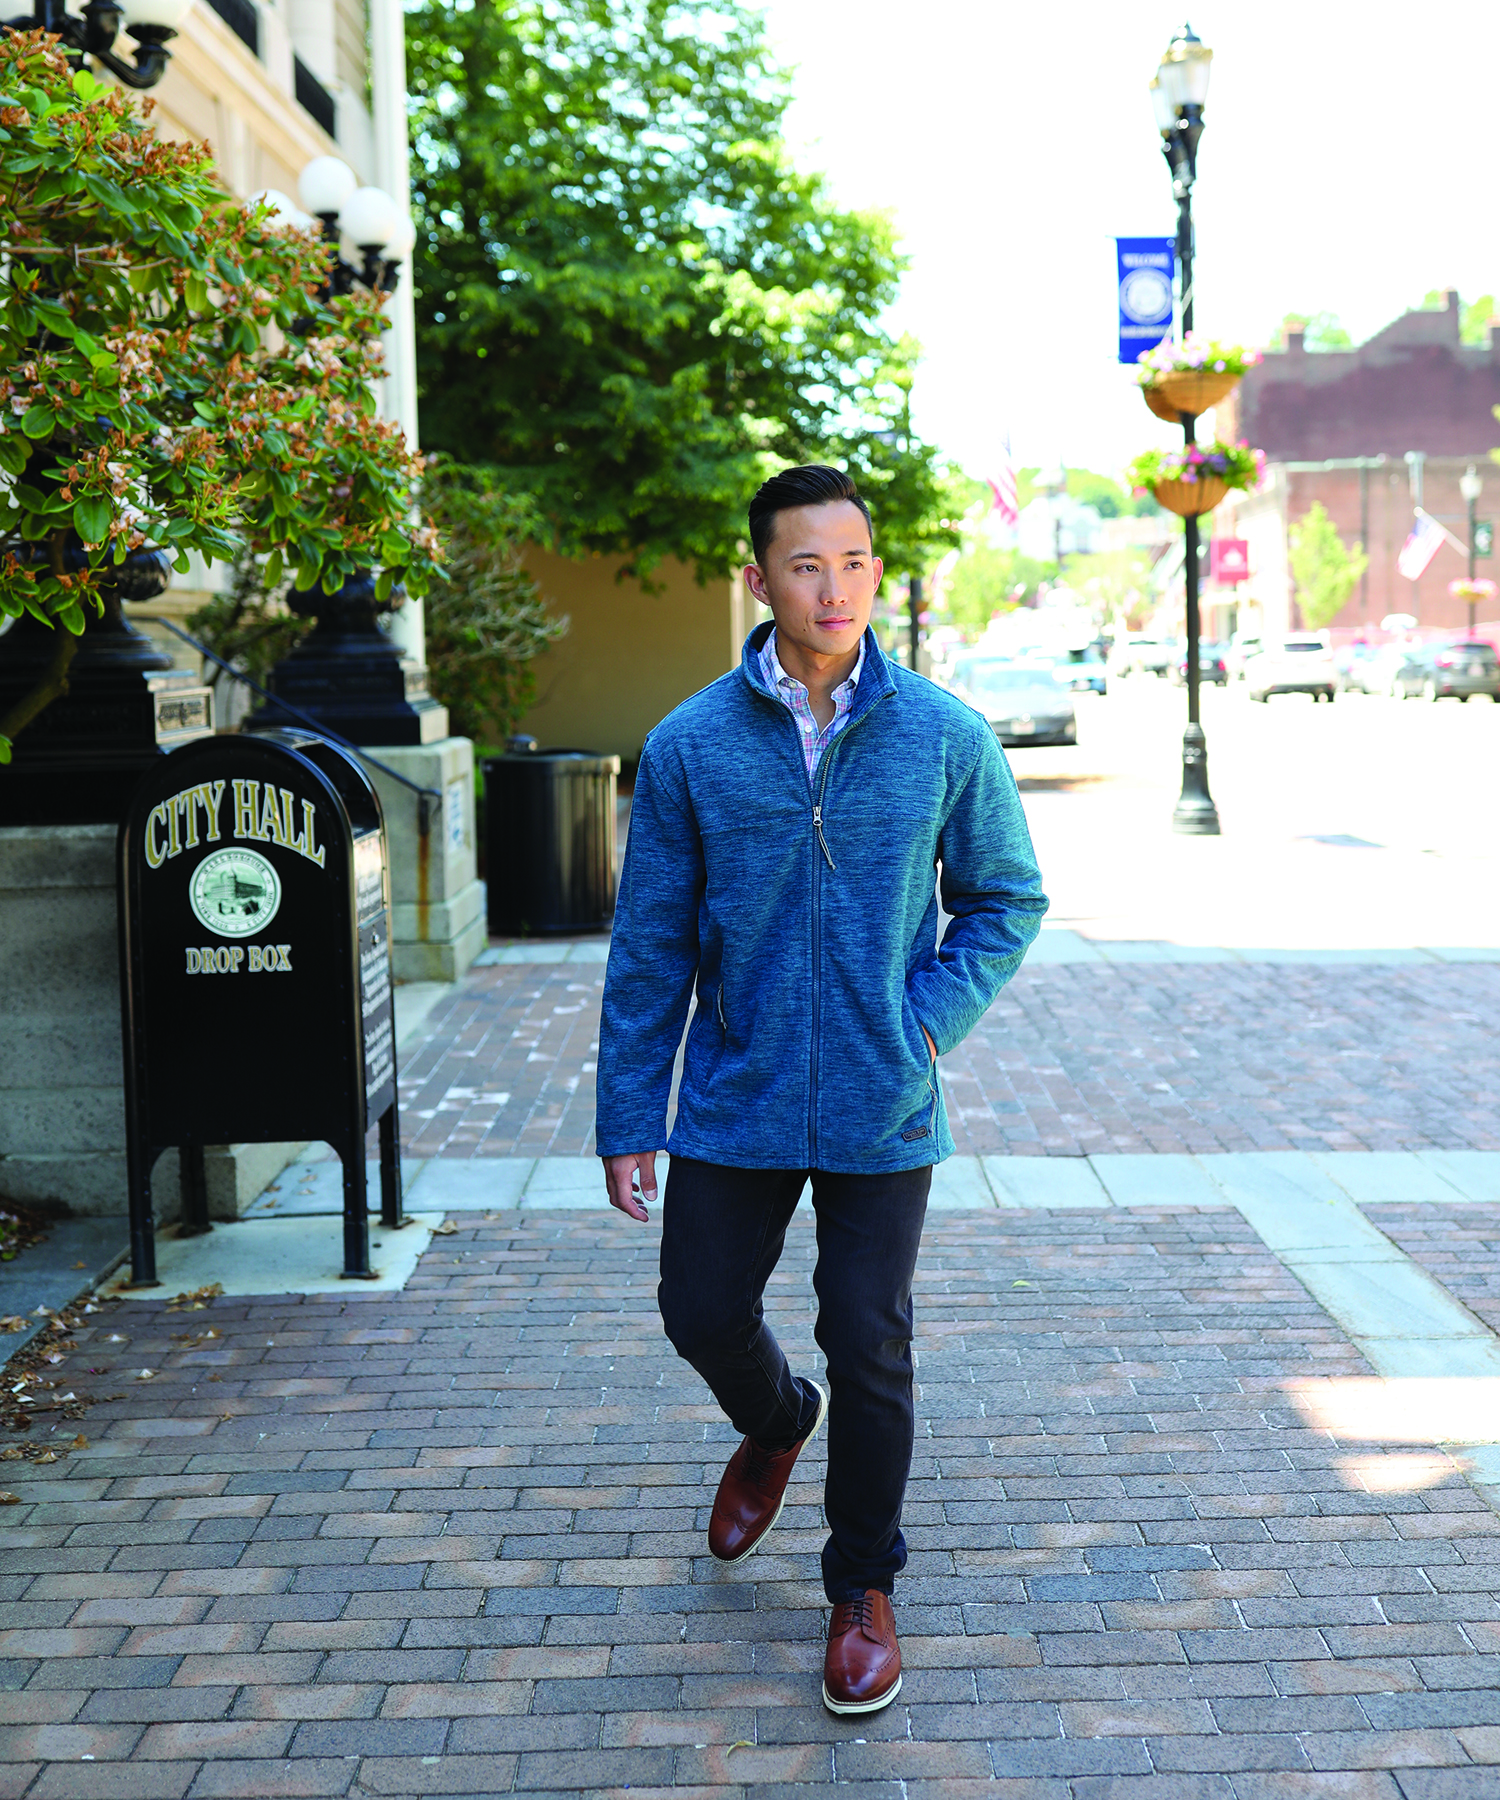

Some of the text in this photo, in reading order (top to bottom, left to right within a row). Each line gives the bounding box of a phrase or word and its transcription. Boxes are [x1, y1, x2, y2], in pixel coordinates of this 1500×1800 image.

[145, 778, 326, 869] CITY HALL
[185, 944, 293, 974] DROP BOX
